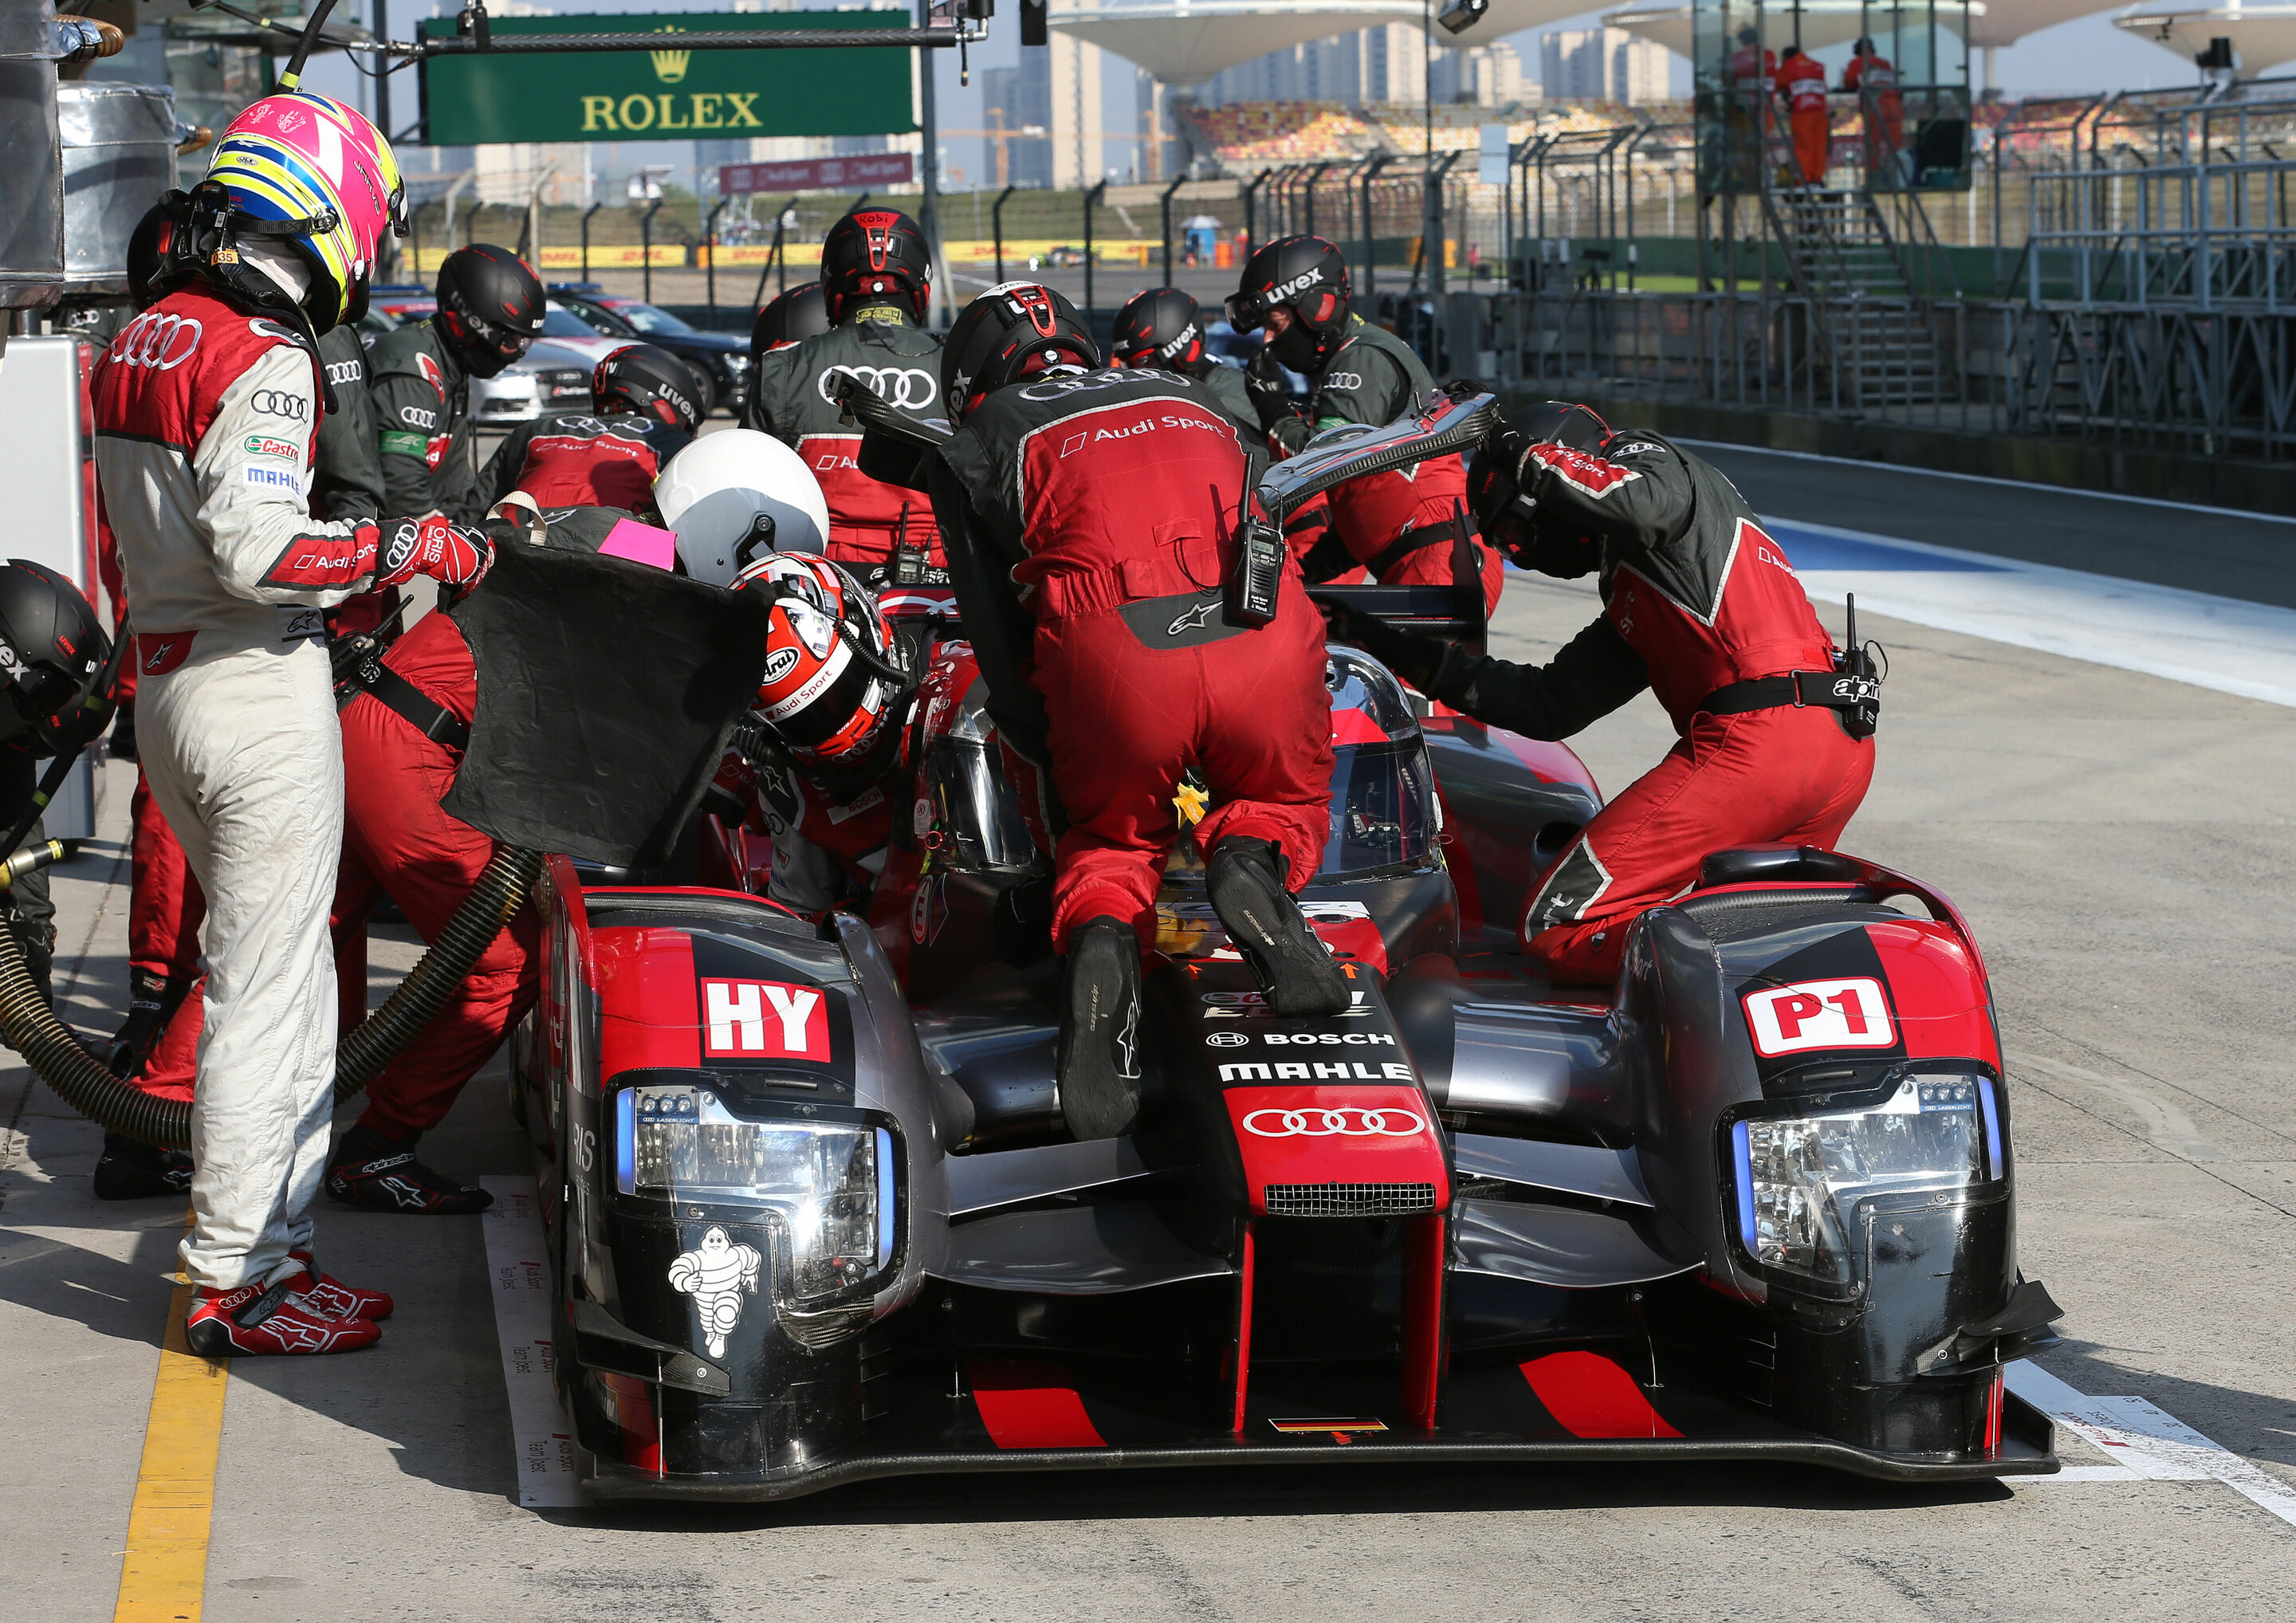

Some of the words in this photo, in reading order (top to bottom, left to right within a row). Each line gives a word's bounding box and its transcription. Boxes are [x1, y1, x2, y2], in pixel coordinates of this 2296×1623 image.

[581, 93, 763, 131] ROLEX
[859, 213, 889, 224] Robi
[214, 252, 233, 263] 035
[1266, 268, 1323, 304] uvex
[1024, 296, 1047, 306] uvex
[450, 291, 493, 339] uvex
[1162, 322, 1197, 359] uvex
[658, 383, 696, 424] uvex
[1094, 419, 1155, 442] Audi
[1161, 415, 1225, 438] Sport
[596, 441, 639, 457] Sport
[1572, 457, 1606, 478] Sport
[248, 468, 300, 497] MAHLE
[429, 527, 446, 564] ORIS
[316, 556, 348, 569] Audi
[59, 635, 77, 655] uvex
[776, 697, 800, 716] Audi
[800, 669, 832, 699] Sport
[706, 983, 820, 1052] HY
[1771, 988, 1869, 1039] P1
[1263, 1034, 1395, 1045] BOSCH
[1218, 1063, 1413, 1081] MAHLE
[513, 1346, 530, 1360] Team
[512, 1360, 533, 1373] Joest
[529, 1440, 548, 1456] Team
[558, 1441, 572, 1453] Audi
[527, 1457, 551, 1472] Joest
[556, 1454, 575, 1472] Sport
